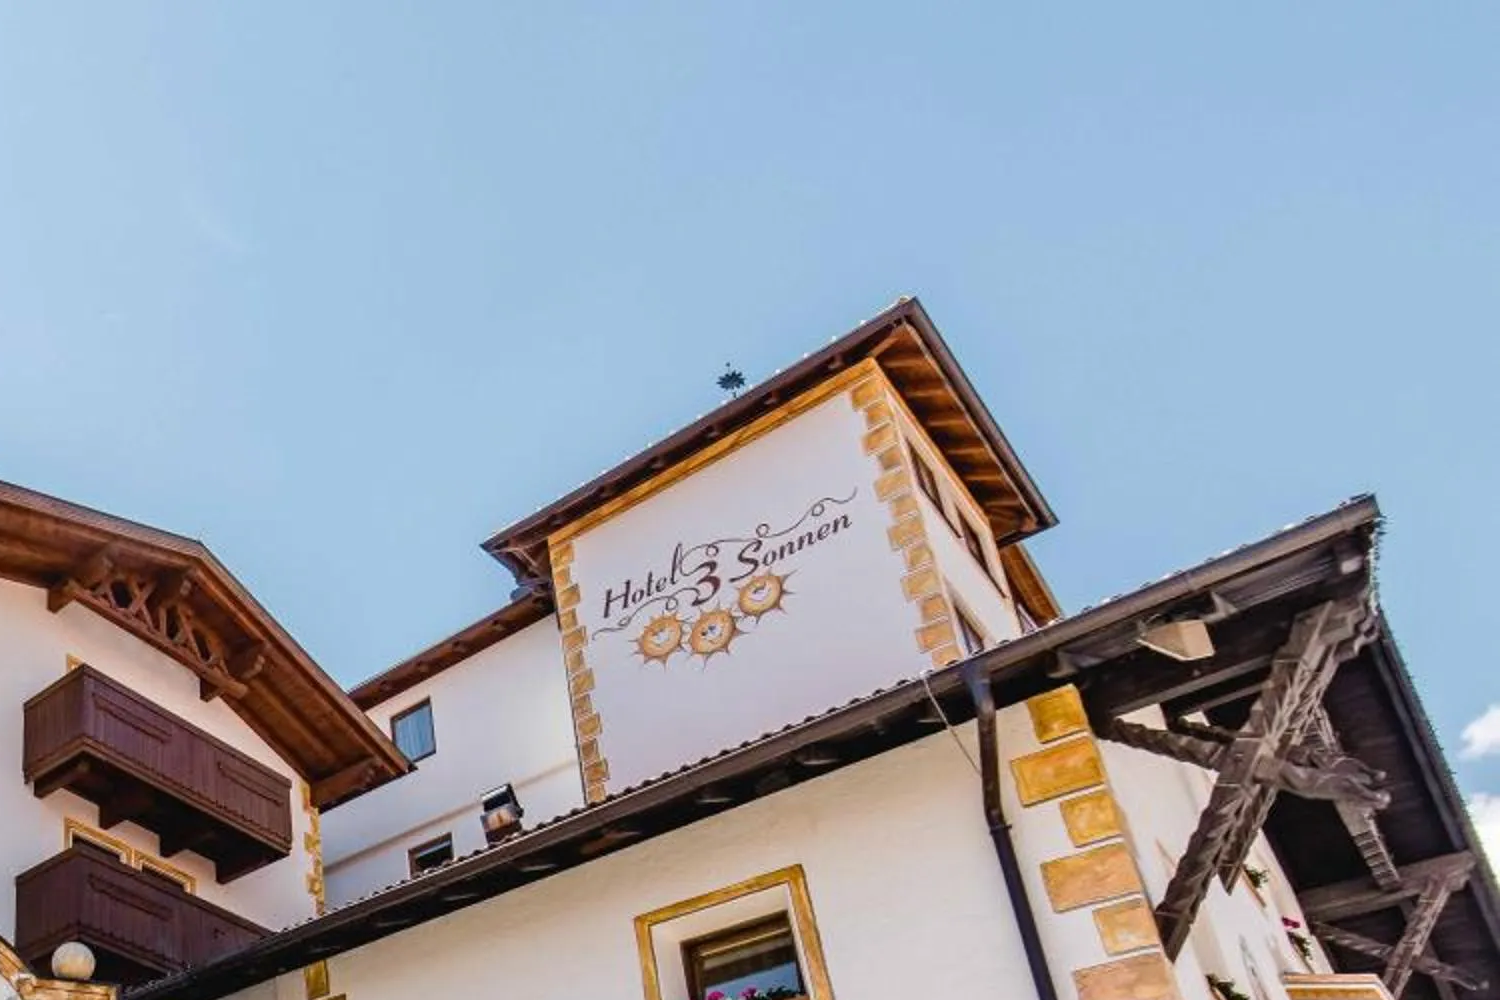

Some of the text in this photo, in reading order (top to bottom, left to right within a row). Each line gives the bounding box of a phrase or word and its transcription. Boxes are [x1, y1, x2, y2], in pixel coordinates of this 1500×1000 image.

[602, 513, 852, 619] Hotel 3 Sonnen
